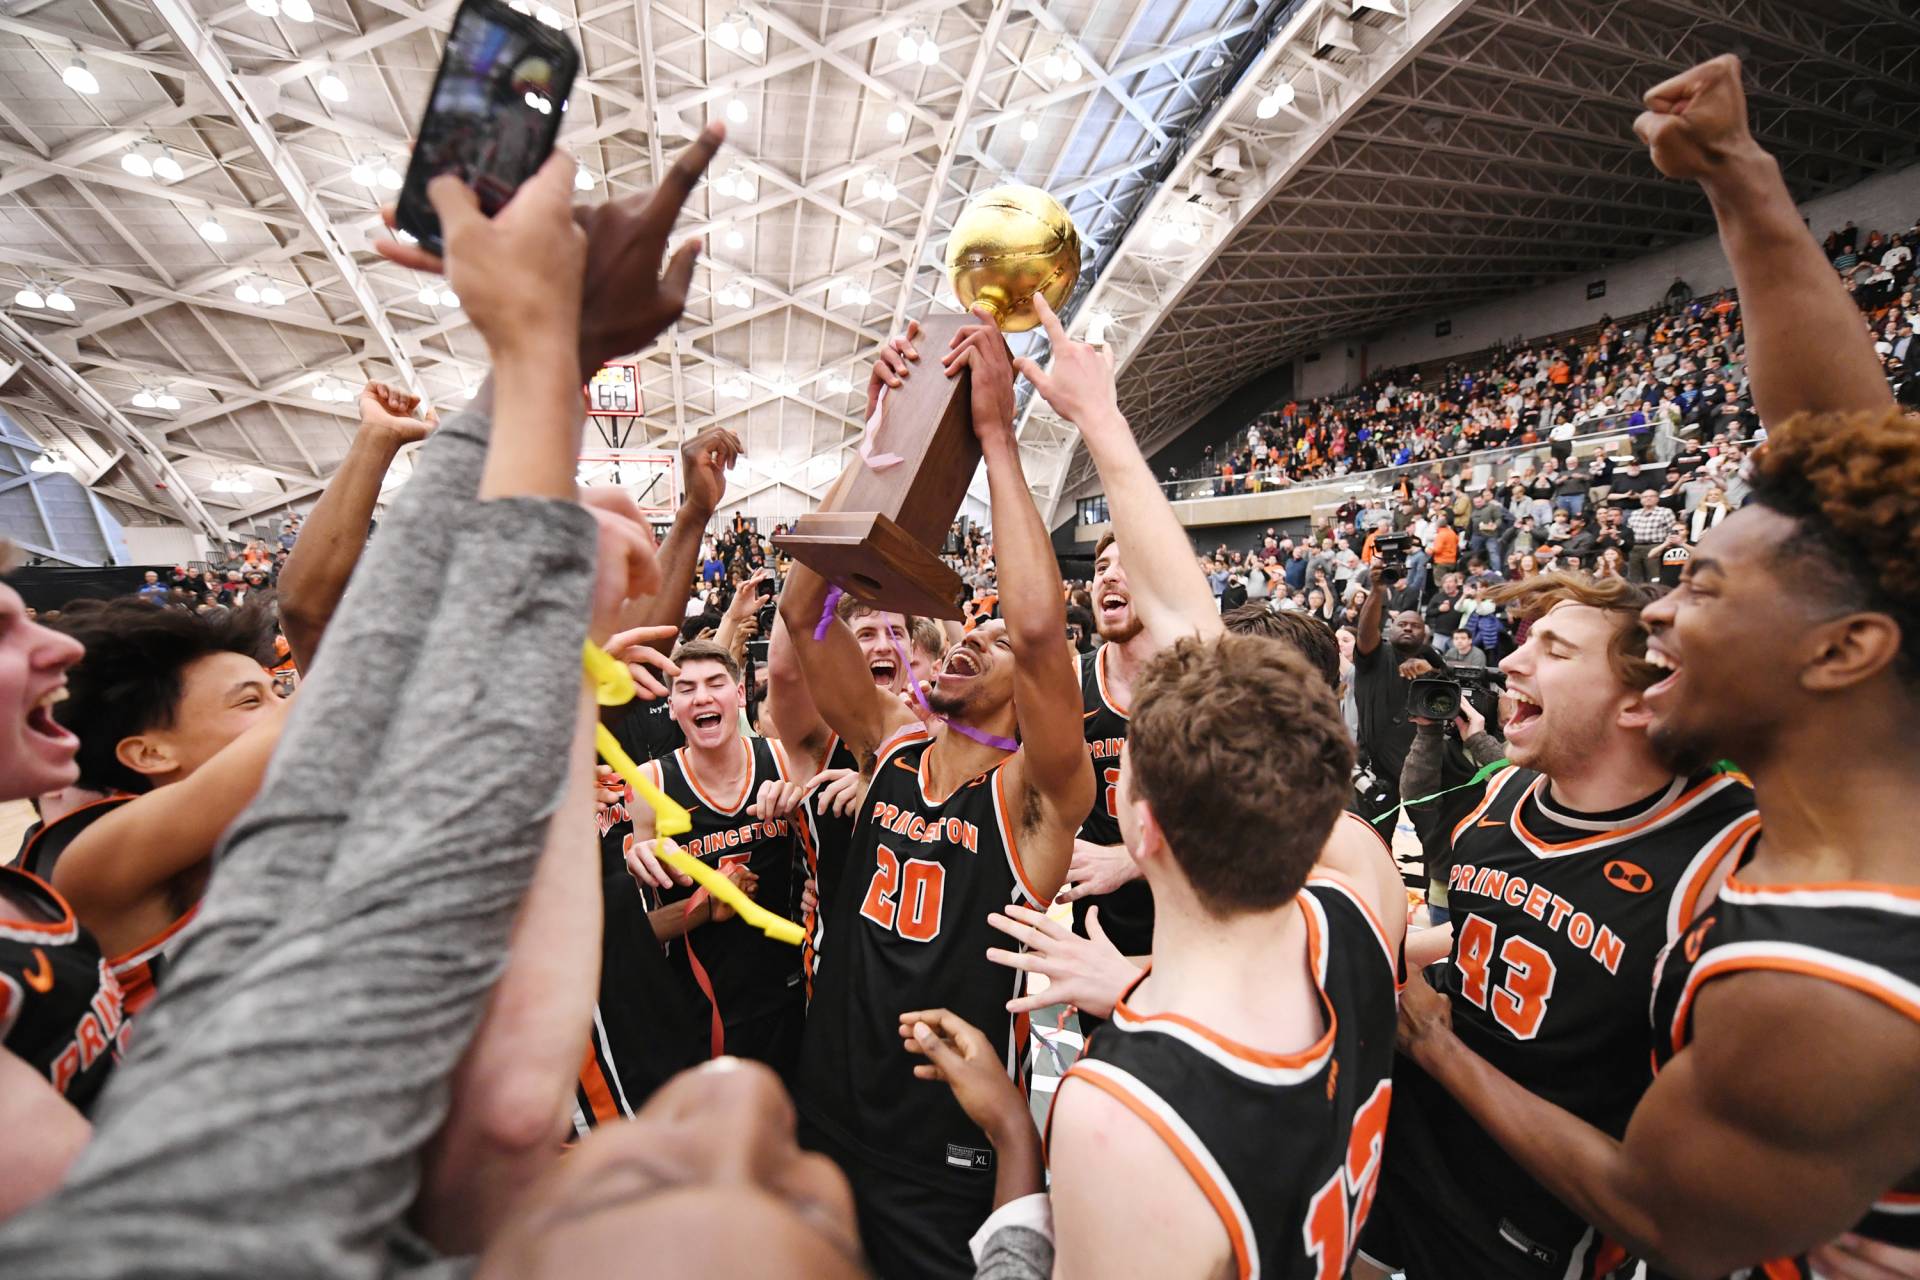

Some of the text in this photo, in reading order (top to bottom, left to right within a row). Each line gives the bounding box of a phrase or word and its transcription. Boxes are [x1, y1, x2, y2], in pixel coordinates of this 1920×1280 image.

[859, 843, 946, 943] 20
[1448, 864, 1626, 976] PRINCETON
[1455, 912, 1557, 1040] 43
[975, 1155, 987, 1165] XL
[1533, 1248, 1550, 1263] XL
